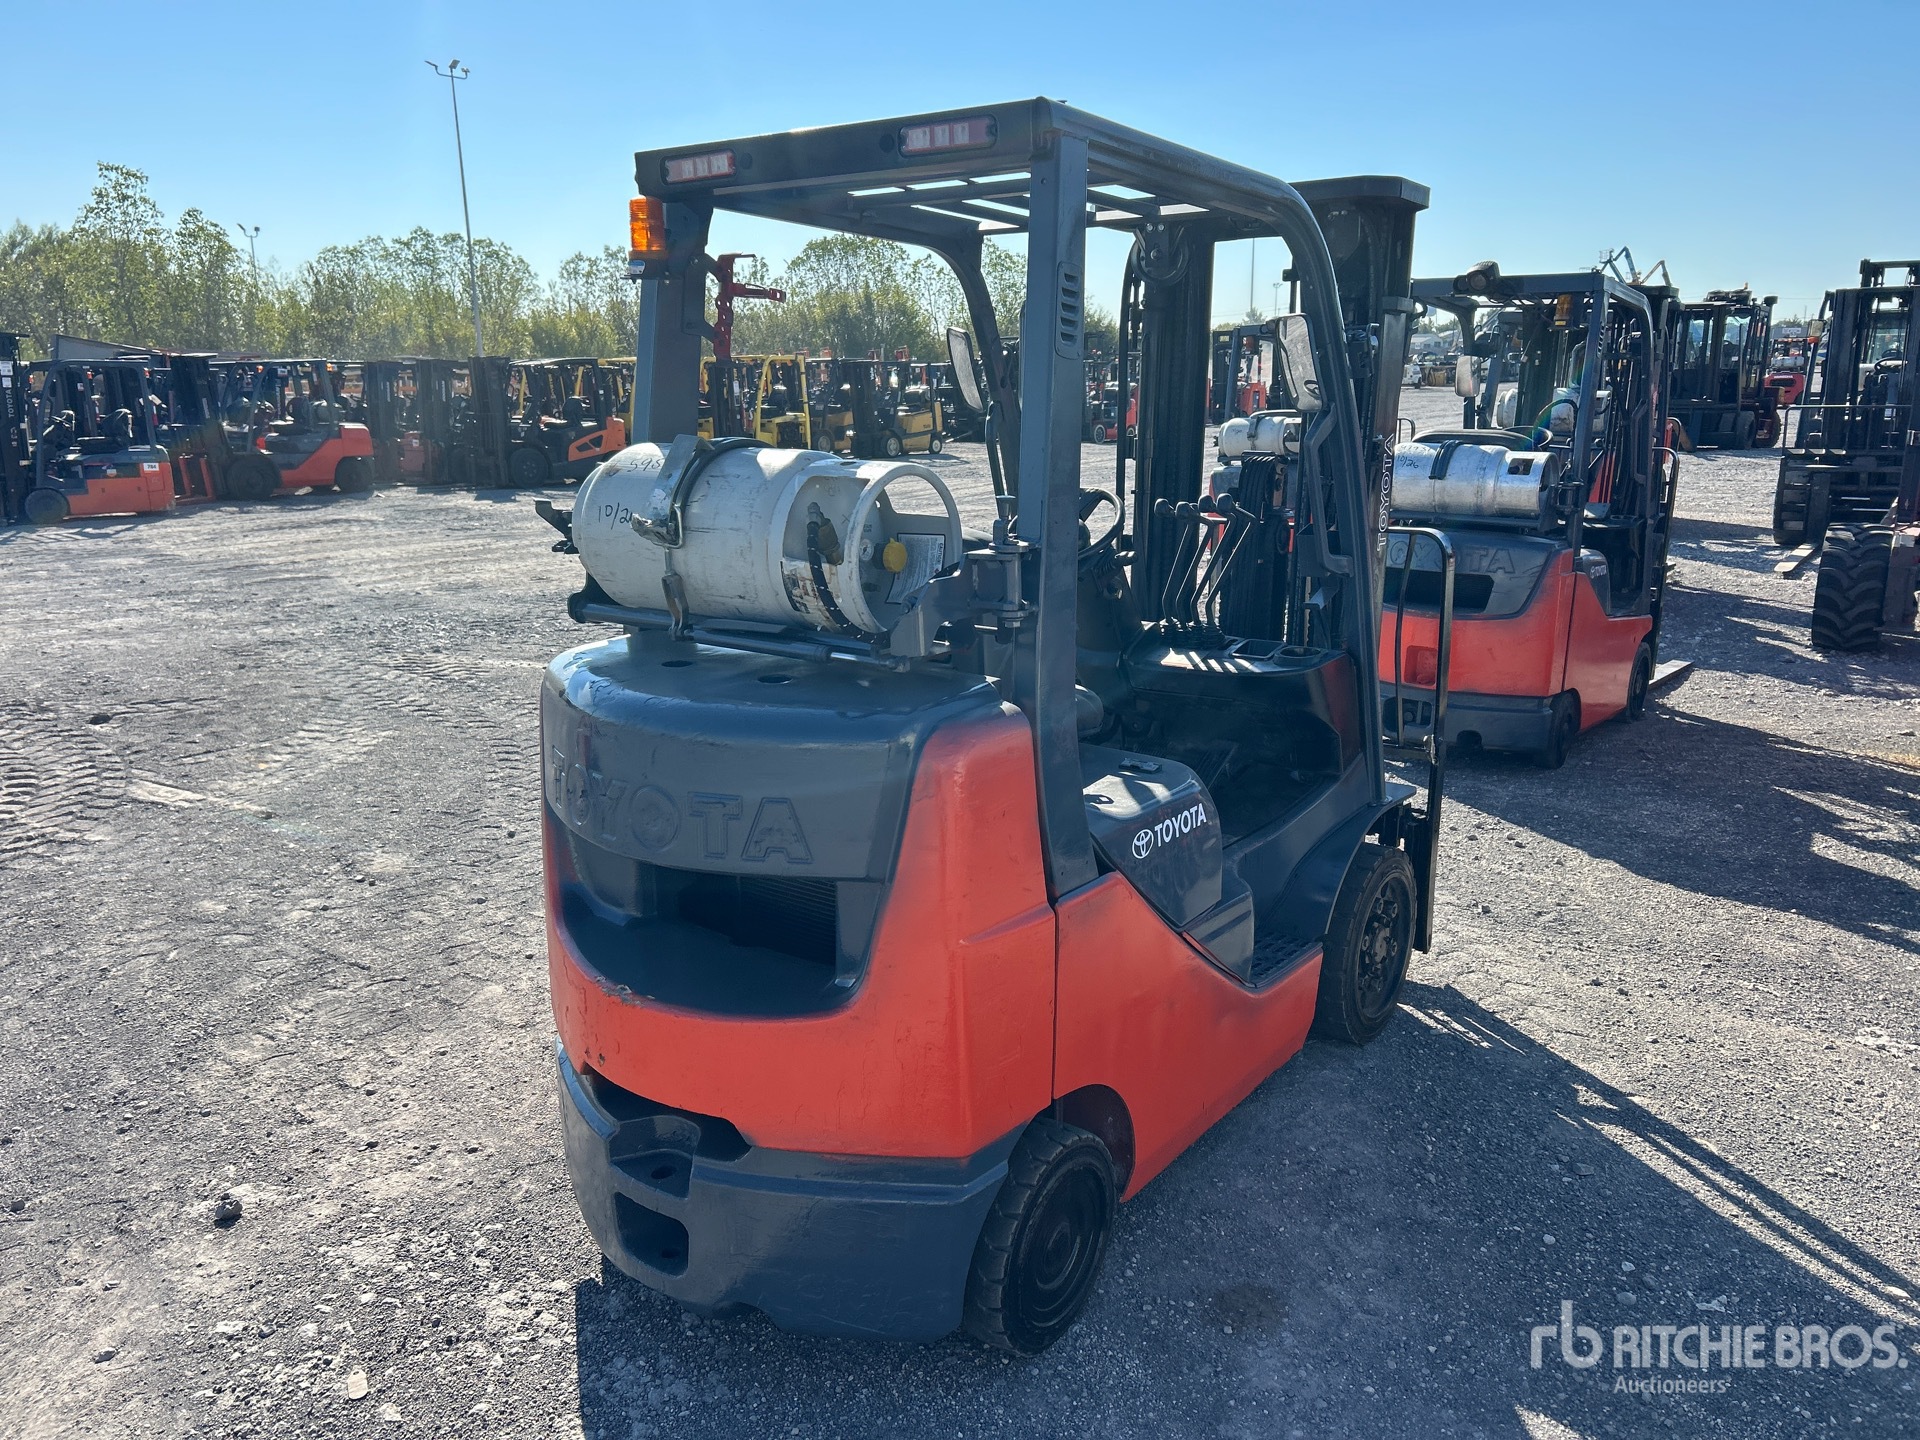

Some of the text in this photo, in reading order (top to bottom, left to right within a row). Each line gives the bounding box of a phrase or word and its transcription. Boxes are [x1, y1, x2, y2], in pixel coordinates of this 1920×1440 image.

[5, 389, 15, 418] TOYOTA
[1377, 433, 1394, 552] TOYOTA
[551, 745, 813, 864] TOYOTA
[1154, 803, 1207, 847] TOYOTA
